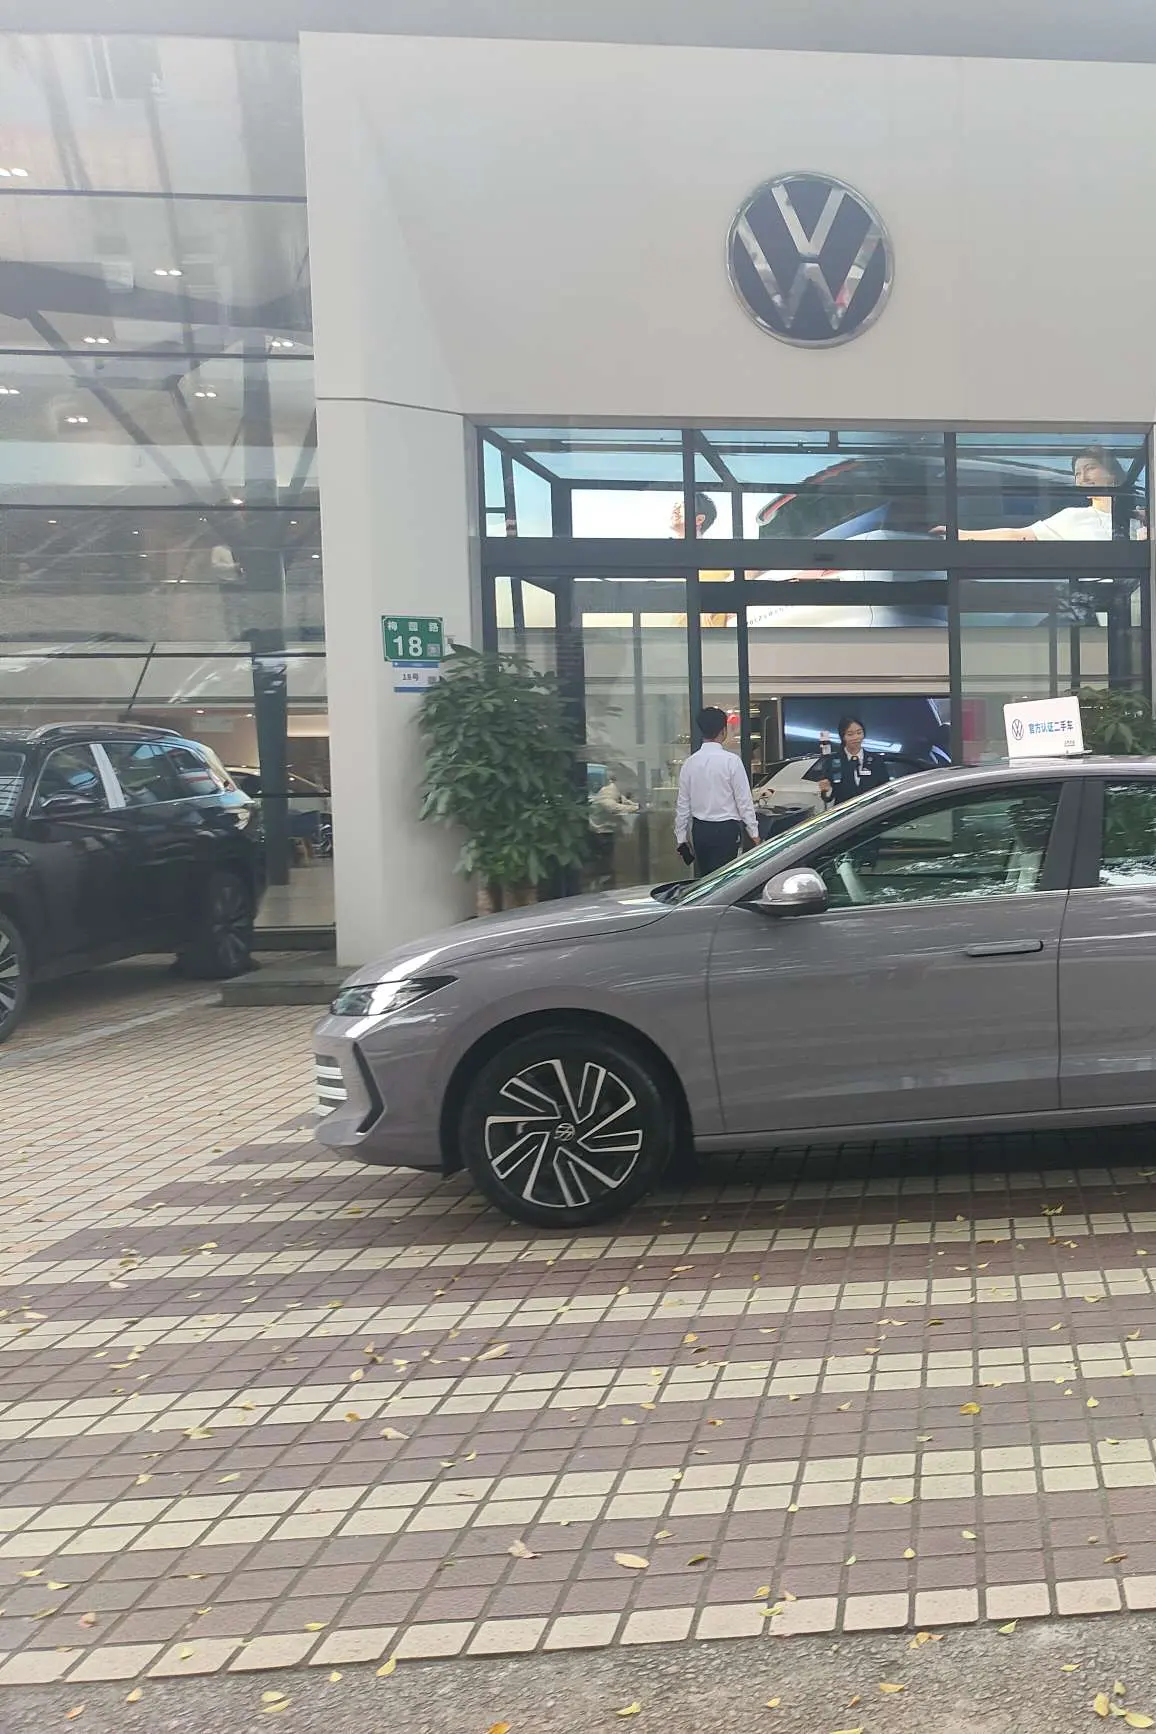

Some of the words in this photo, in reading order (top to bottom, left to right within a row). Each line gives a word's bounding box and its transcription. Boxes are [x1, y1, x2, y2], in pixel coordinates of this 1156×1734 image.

[393, 635, 423, 657] 18
[1028, 720, 1074, 734] 官方认证二手车
